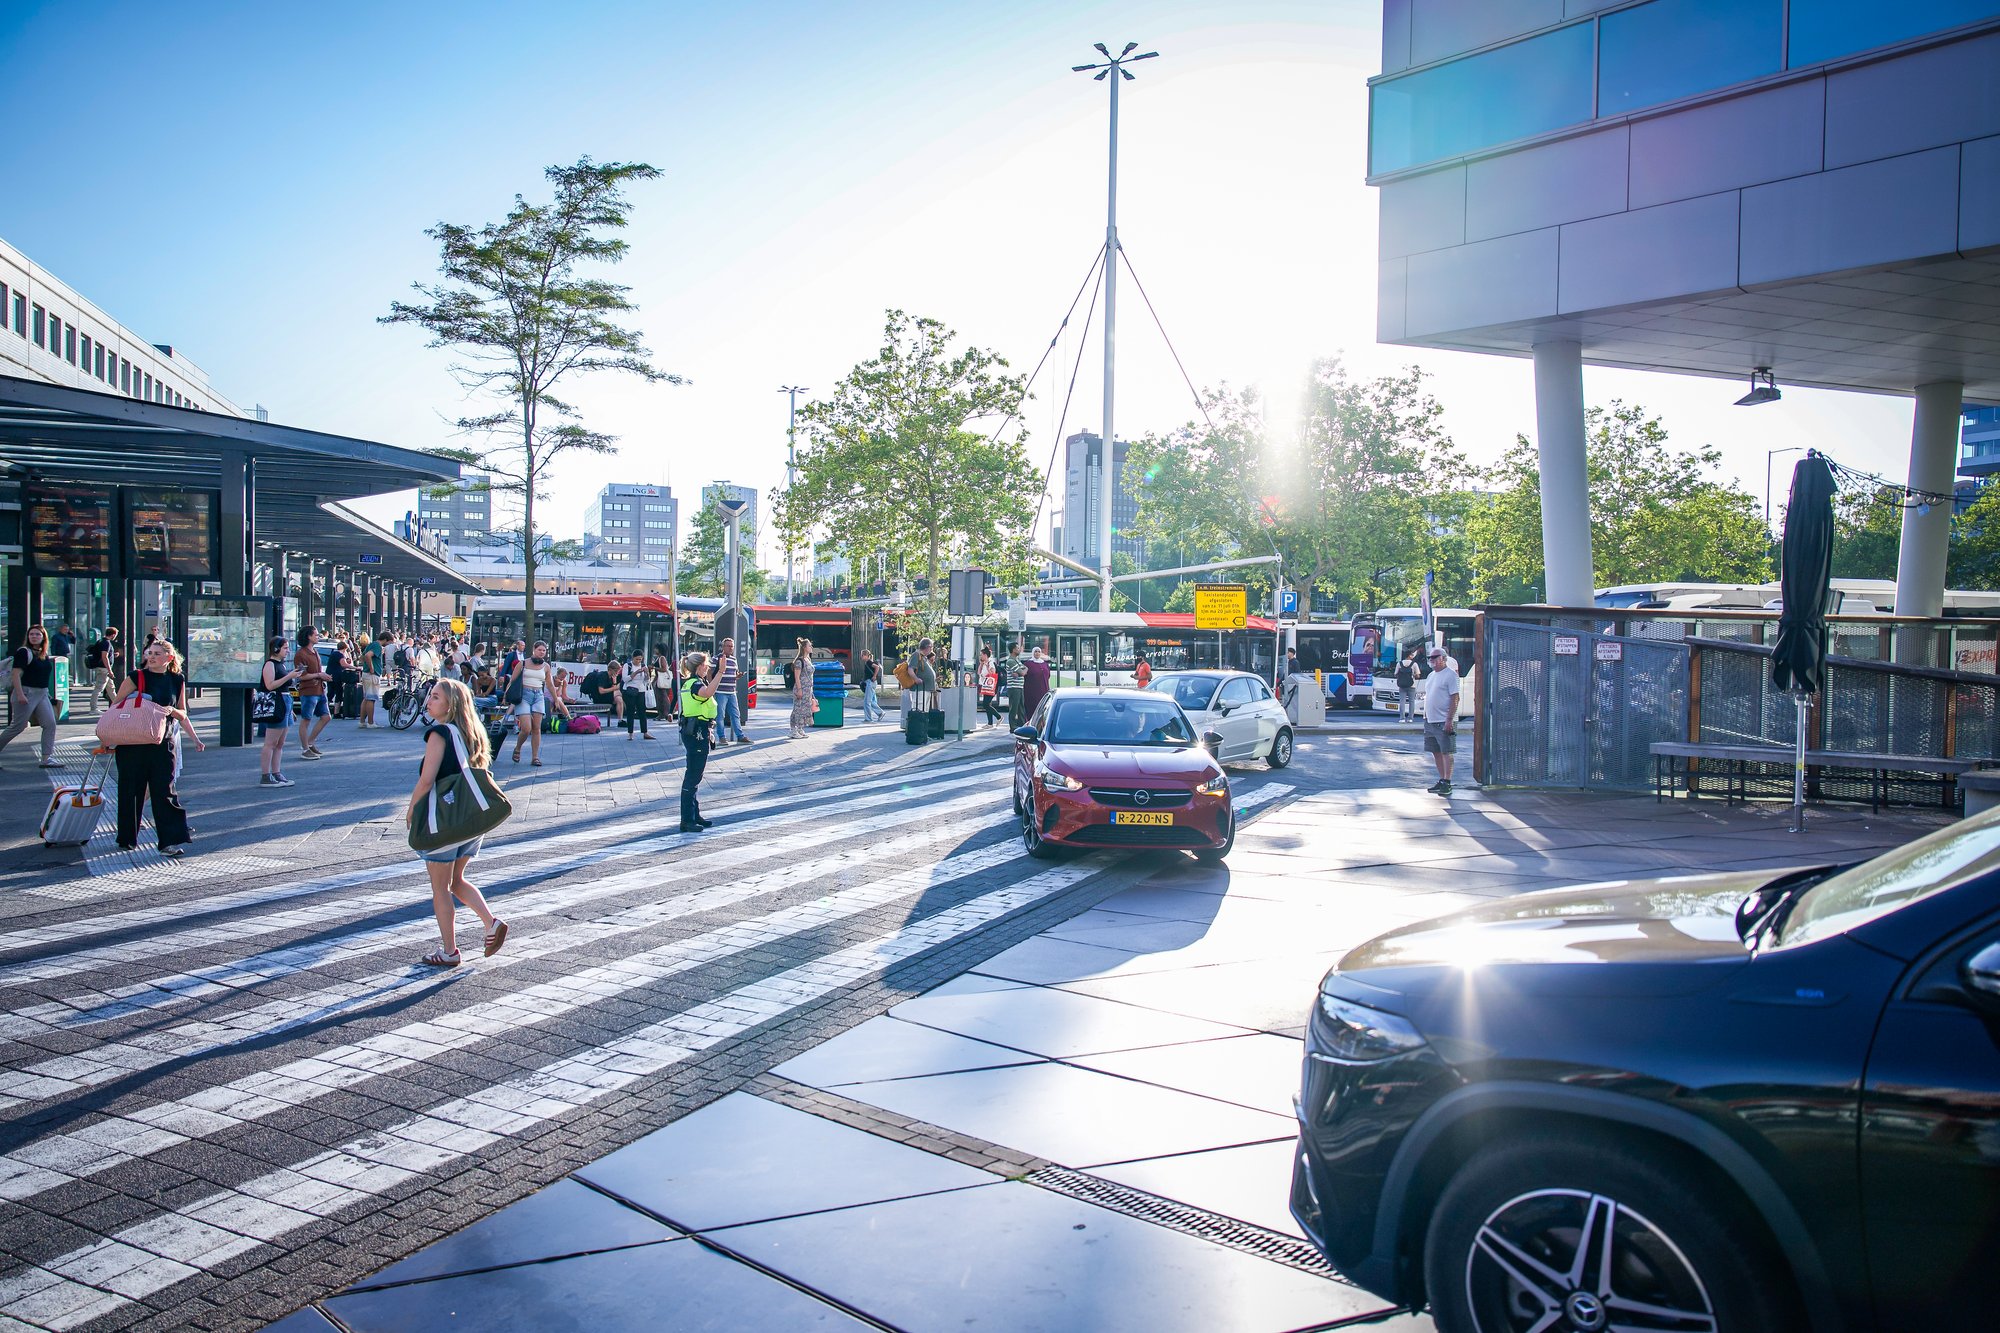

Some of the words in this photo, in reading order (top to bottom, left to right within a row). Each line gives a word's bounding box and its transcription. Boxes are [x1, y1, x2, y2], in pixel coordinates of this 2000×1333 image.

[1284, 594, 1294, 608] P
[1145, 647, 1173, 658] ervoert
[1332, 649, 1349, 659] Brab
[1118, 813, 1169, 824] R-220-NS
